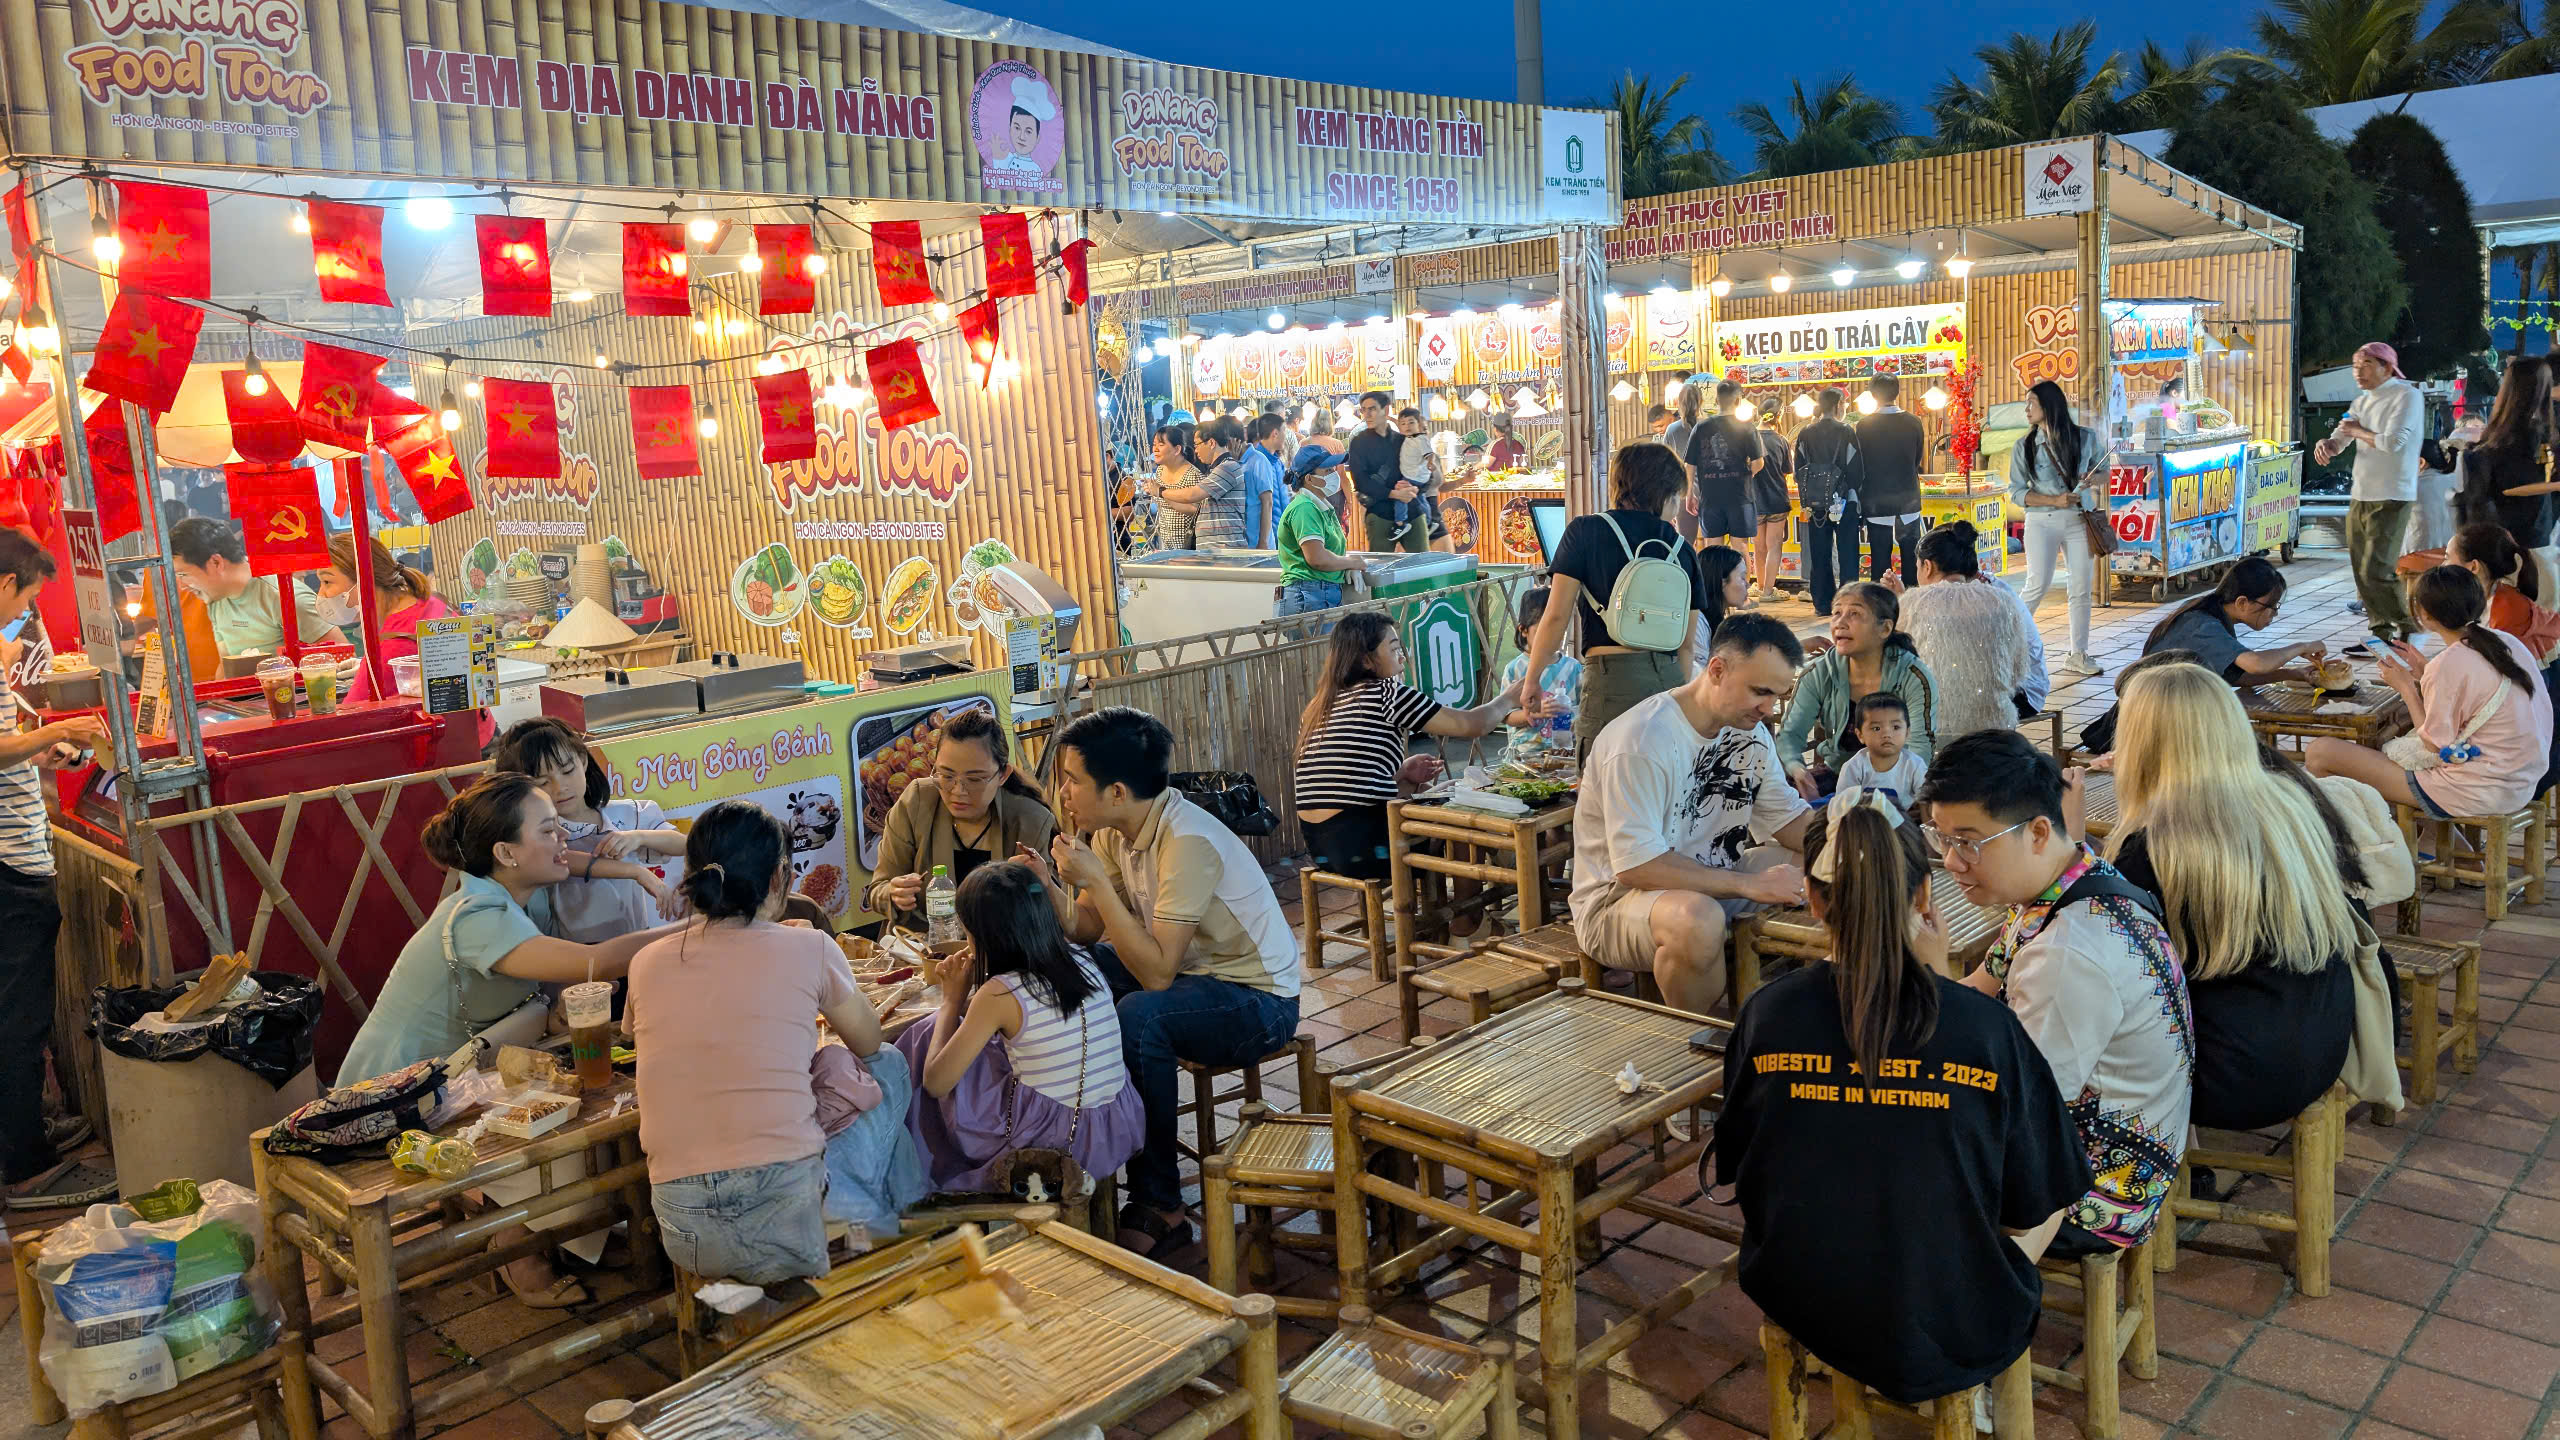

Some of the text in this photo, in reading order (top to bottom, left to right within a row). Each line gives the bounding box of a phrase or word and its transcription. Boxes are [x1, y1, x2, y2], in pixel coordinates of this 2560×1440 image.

[409, 47, 936, 142] KEM ĐỊA DANH ĐÀ NẴNG
[165, 118, 203, 131] NGON
[213, 121, 263, 136] BEYOND
[266, 125, 299, 138] BITES
[1296, 107, 1483, 158] KEM TRÀNG TIỀN
[1328, 172, 1459, 215] SINCE 1958
[1545, 177, 1561, 187] KEM
[1563, 175, 1587, 188] TRÀNG
[2036, 184, 2081, 200] Món Việt
[1665, 199, 1725, 225] THỰC
[1732, 189, 1788, 217] VIỆT
[1626, 237, 1656, 258] HOA
[1690, 225, 1734, 250] THỰC
[1739, 220, 1785, 245] VÙNG
[1791, 209, 1834, 239] MIỀN
[1223, 288, 1241, 302] TINH
[1244, 286, 1259, 301] HOA
[1745, 316, 1930, 362] KẸO DẺO TRÁI CÂY
[2113, 319, 2147, 353] KEM
[1500, 368, 1520, 380] Hoa
[2110, 464, 2151, 496] EM
[2171, 473, 2199, 524] KEM
[834, 522, 863, 538] NGON
[870, 523, 912, 539] BEYOND
[914, 523, 944, 538] BITES
[67, 525, 103, 575] 25K
[87, 590, 101, 611] ICE
[426, 621, 461, 634] Menu
[10, 637, 48, 687] ola
[632, 752, 697, 793] Mây
[703, 738, 771, 783] Bồng
[772, 722, 833, 764] Bềnh
[1753, 1053, 1832, 1074] VIBESTU
[1879, 1058, 1921, 1079] EST
[1943, 1062, 1998, 1092] 2023
[1790, 1083, 1949, 1109] MADE IN VIETNAM
[55, 1187, 106, 1206] crocs
